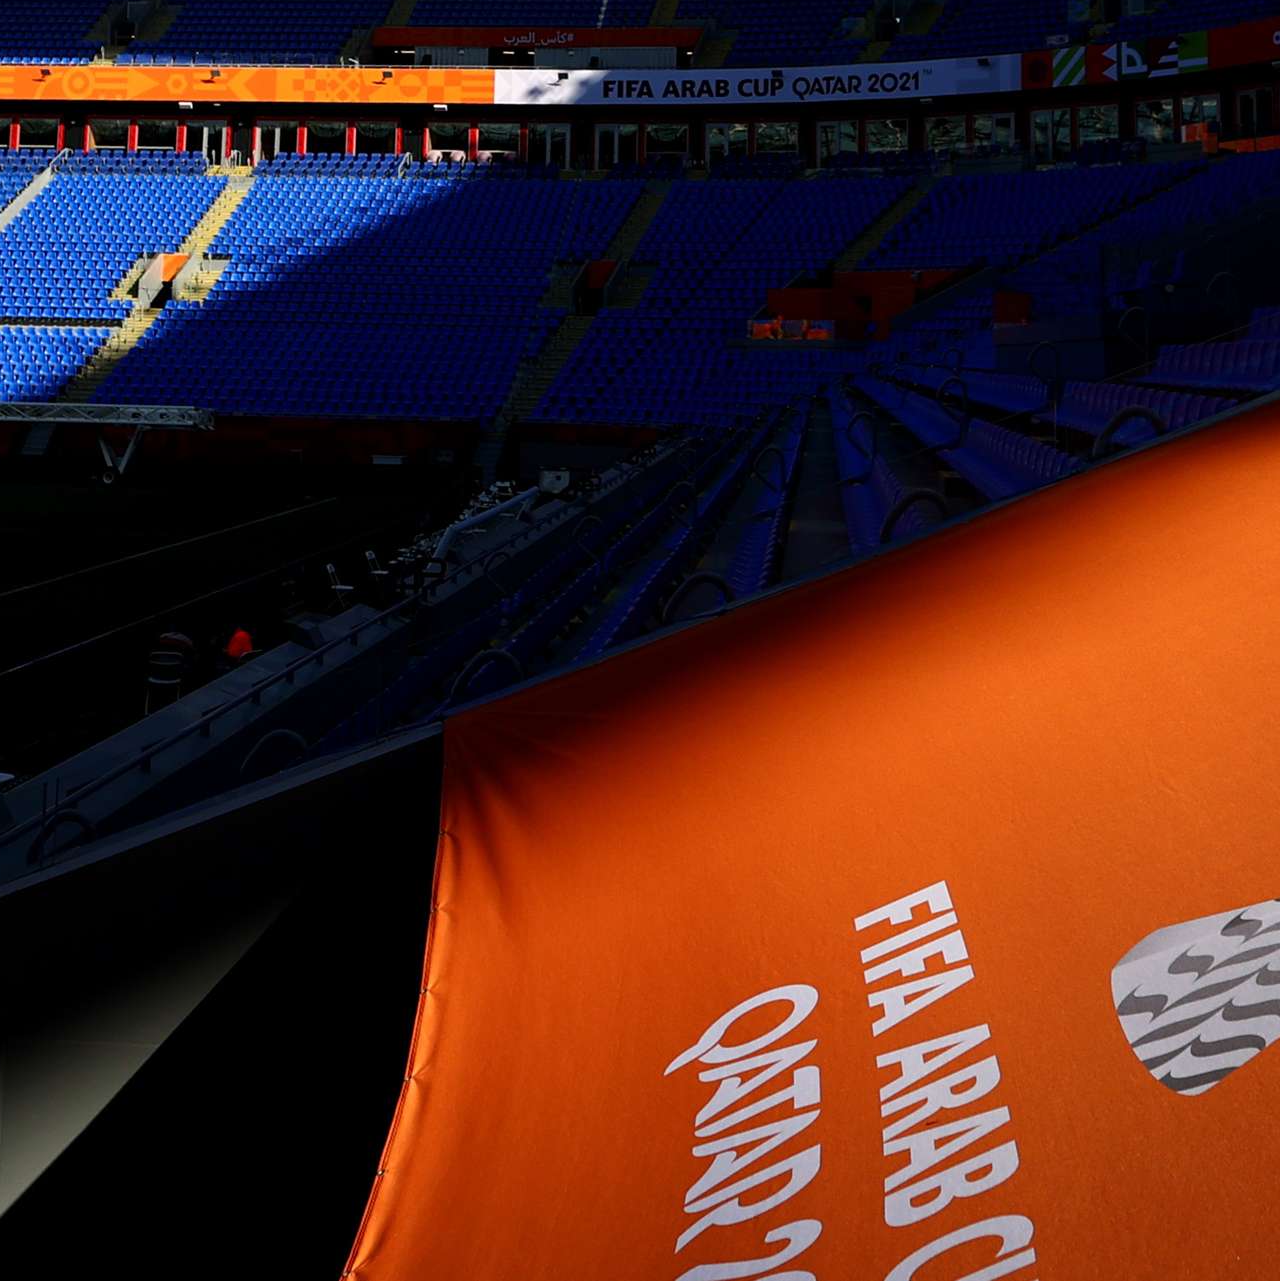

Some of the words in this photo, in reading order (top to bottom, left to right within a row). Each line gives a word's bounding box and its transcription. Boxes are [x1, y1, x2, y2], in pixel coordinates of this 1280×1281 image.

[602, 79, 654, 99] FIFA
[662, 78, 730, 99] ARAB
[737, 77, 784, 99] CUP
[791, 76, 861, 100] QATAR
[867, 72, 920, 93] 2021
[853, 880, 975, 1037] FIFA
[663, 983, 821, 1254] QATAR
[876, 1023, 1020, 1227] ARAB
